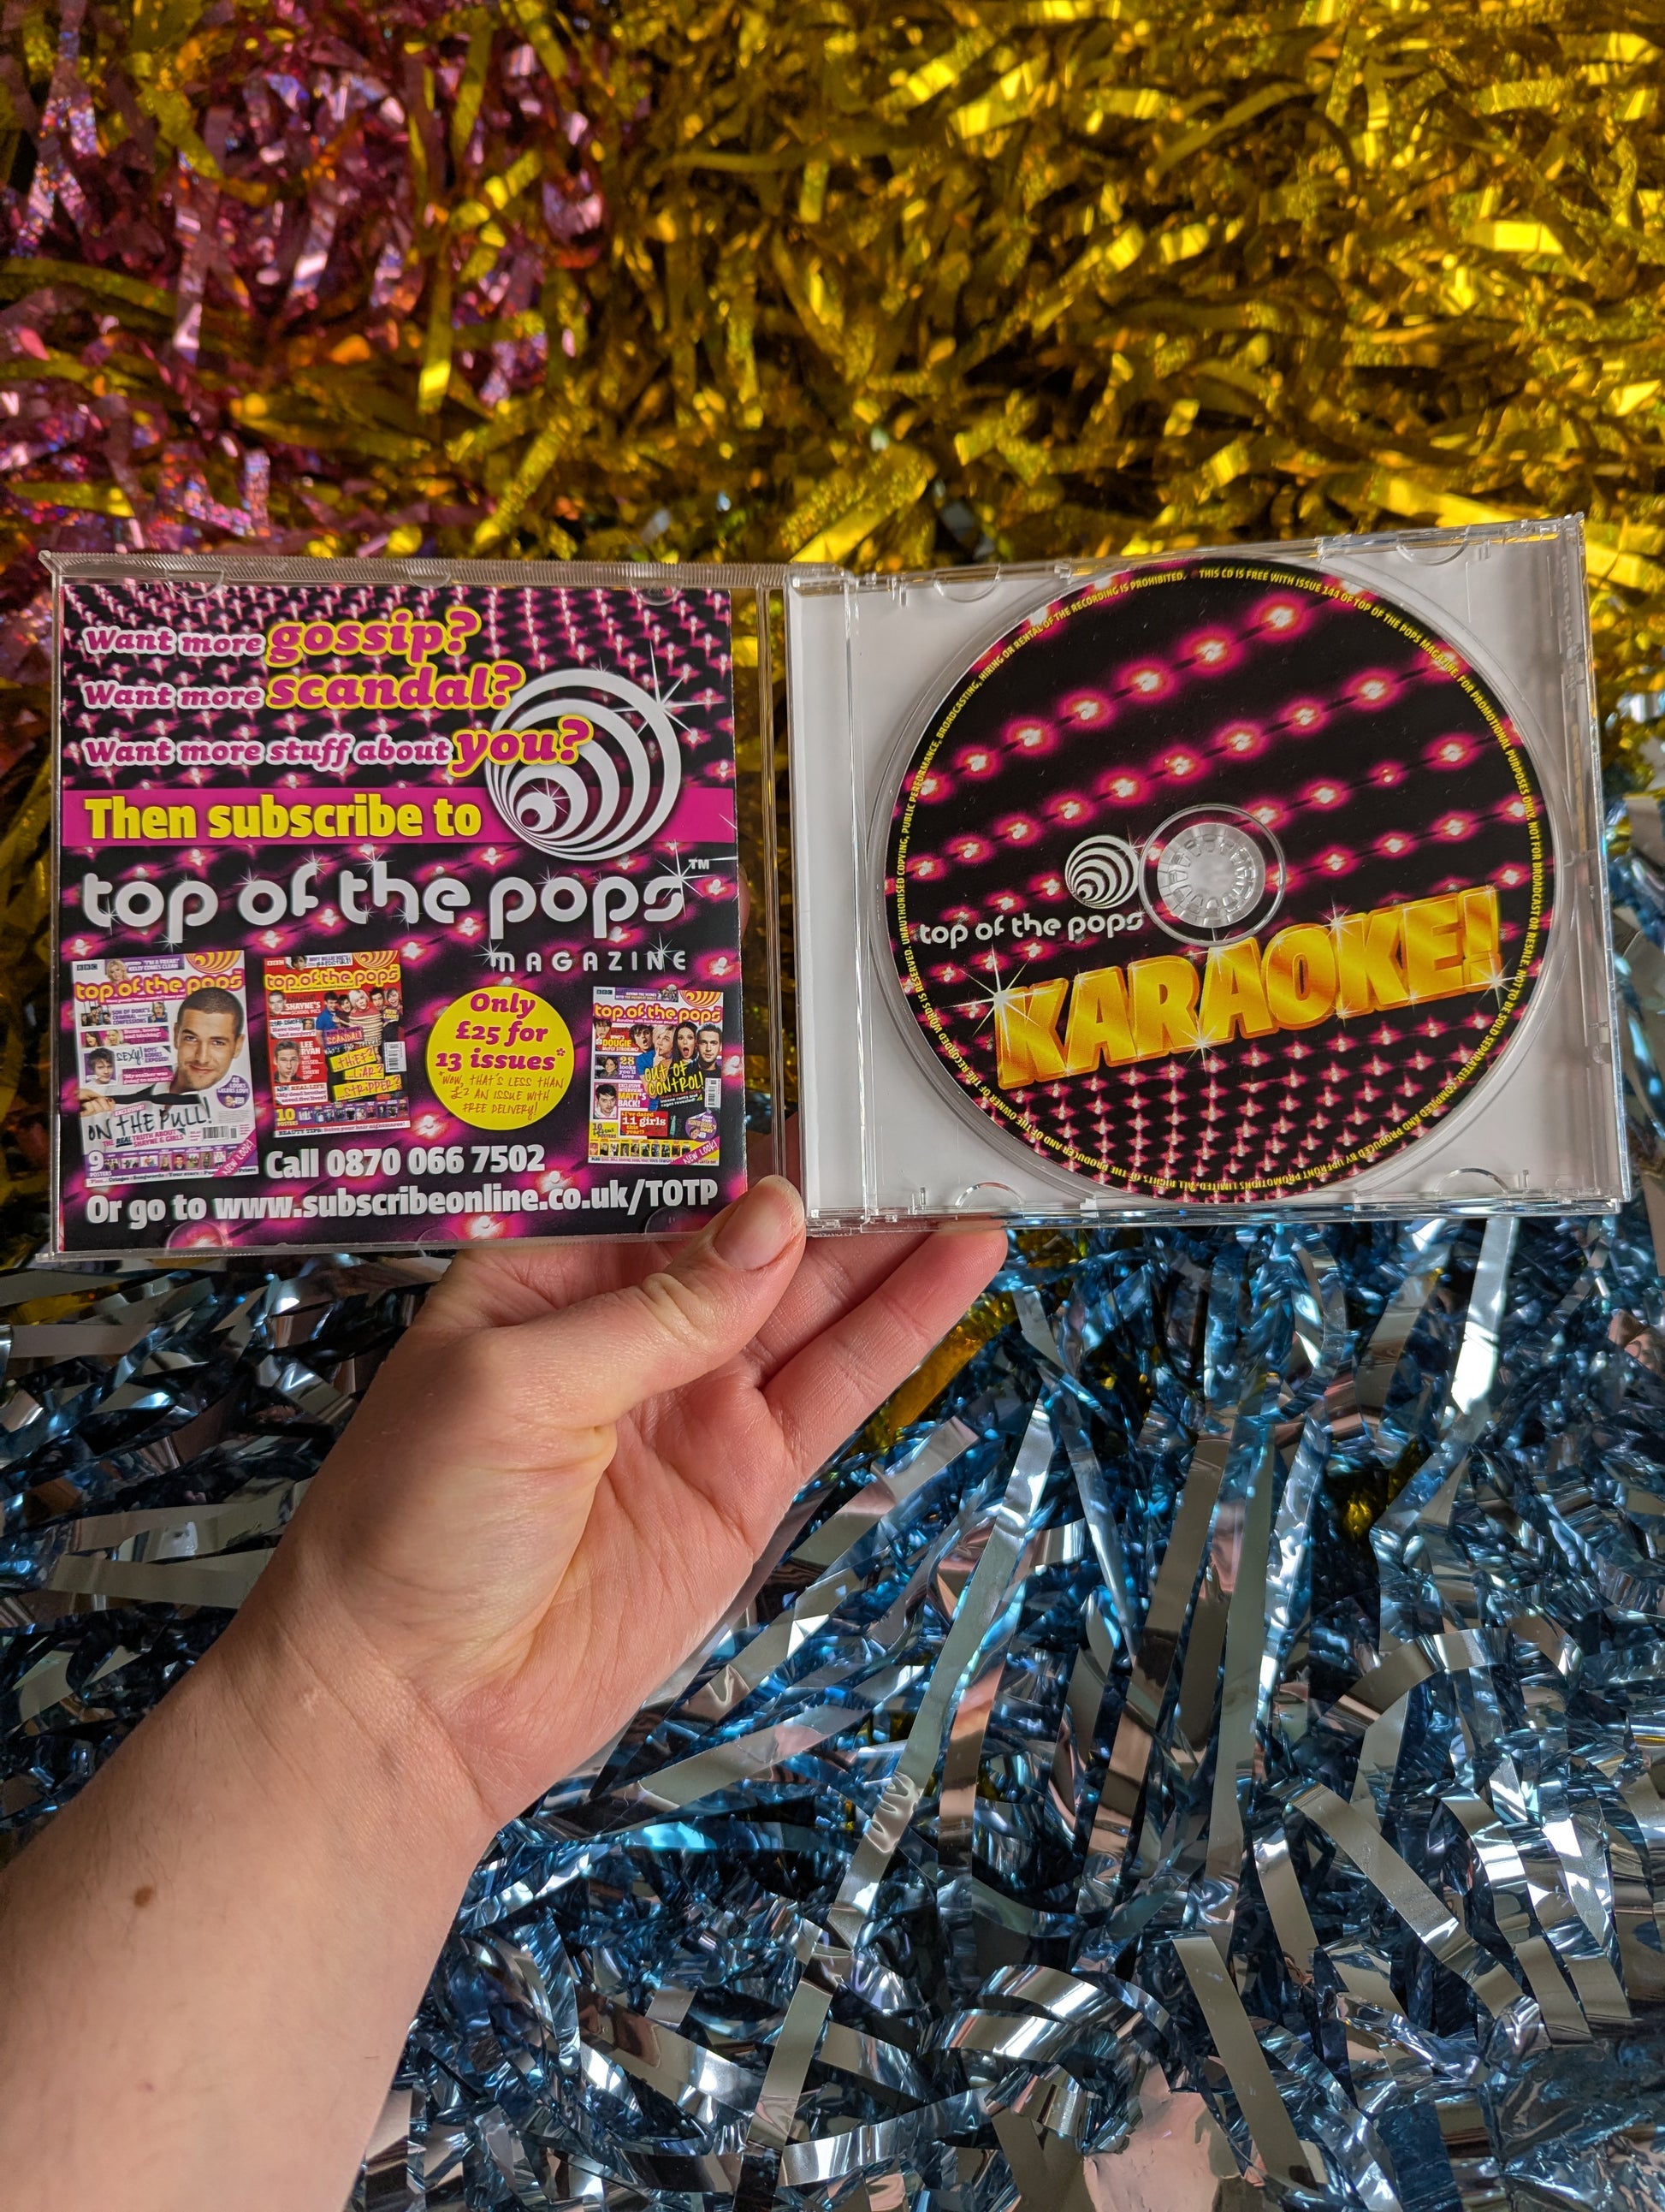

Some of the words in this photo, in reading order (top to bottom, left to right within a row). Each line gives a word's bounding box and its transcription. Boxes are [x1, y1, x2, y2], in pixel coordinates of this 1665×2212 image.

[1198, 568, 1219, 578] THIS
[1221, 568, 1234, 578] CD
[1235, 568, 1244, 578] IS
[1245, 569, 1270, 581] FREE
[1269, 572, 1295, 585] WITH
[1118, 582, 1130, 594] IS
[1294, 577, 1323, 593] ISSUE
[1320, 584, 1341, 599] 144
[1070, 585, 1120, 614] RECORDING
[1339, 591, 1355, 605] OF
[1352, 596, 1372, 613] TOP
[1040, 614, 1057, 630] OF
[1053, 606, 1072, 622] THE
[1369, 605, 1384, 619] OF
[1381, 612, 1401, 629] THE
[83, 626, 176, 655] Want
[178, 633, 265, 657] more
[265, 607, 481, 667] gossip?
[1011, 622, 1045, 650] RENTAL
[1397, 622, 1423, 643] POPS
[1000, 644, 1016, 660] OR
[977, 654, 1005, 682] HIRING
[83, 680, 175, 709] Want
[177, 686, 265, 709] more
[266, 661, 526, 710] scandal?
[1455, 673, 1475, 694] FOR
[1468, 690, 1512, 750] PROMOTIONAL
[82, 737, 175, 766] Want
[177, 740, 264, 766] more
[267, 733, 354, 772] stuff
[353, 734, 453, 765] about
[448, 715, 594, 777] you?
[1503, 748, 1530, 796] PURPOSES
[84, 796, 197, 839] Then
[208, 793, 424, 838] subscribe
[434, 798, 481, 837] to
[900, 802, 915, 834] PUBLIC
[1520, 795, 1536, 821] ONLY.
[1526, 821, 1539, 841] NOT
[896, 833, 909, 875] COPYING,
[1530, 841, 1541, 861] FOR
[1529, 862, 1542, 916] BROADCAST
[83, 872, 218, 944] top
[237, 860, 319, 926] of
[339, 861, 471, 925] the
[489, 875, 685, 940] pops
[896, 876, 911, 945] UNAUTHORISED
[920, 922, 968, 949] top
[975, 915, 1005, 940] of
[1012, 912, 1061, 939] the
[1068, 912, 1145, 940] pops
[1527, 916, 1538, 931] OR
[1518, 931, 1536, 969] RESALE.
[490, 951, 686, 972] MAGAZINE
[267, 976, 296, 990] top
[300, 971, 319, 985] of
[322, 971, 352, 985] the
[355, 967, 399, 987] pops
[994, 886, 1502, 1089] KARAOKE!
[1511, 968, 1526, 989] NOT
[75, 983, 114, 1003] top
[118, 978, 140, 997] of
[145, 976, 182, 994] the
[917, 991, 928, 1002] IS
[1505, 987, 1520, 1002] TO
[286, 1001, 321, 1010] SHAYNE'S
[471, 993, 536, 1019] Only
[595, 1004, 624, 1021] top
[626, 1004, 644, 1018] of
[648, 1005, 676, 1019] the
[679, 1008, 721, 1023] pops
[1500, 999, 1514, 1014] BE
[921, 1000, 944, 1034] WORDS
[1488, 1011, 1508, 1037] SOLD
[456, 1021, 501, 1045] £25
[504, 1020, 548, 1047] for
[619, 1056, 635, 1065] 28
[937, 1030, 970, 1073] RECORDED
[436, 1053, 462, 1072] 13
[644, 1064, 667, 1082] OUT
[673, 1060, 688, 1076] OF
[508, 1077, 531, 1086] LESS
[537, 1077, 564, 1088] THAN
[649, 1071, 704, 1095] CONTROL!
[964, 1069, 983, 1088] THE
[451, 1087, 469, 1100] £2
[474, 1089, 489, 1100] AN
[494, 1090, 521, 1100] ISSUE
[527, 1090, 550, 1101] WITH
[618, 1092, 646, 1100] MATT'S
[976, 1082, 992, 1097] OF
[1417, 1080, 1458, 1118] COMPILED
[276, 1108, 295, 1121] 10
[463, 1103, 487, 1113] FREE
[492, 1102, 537, 1120] DELIVERY!
[987, 1093, 1018, 1121] OWNER
[88, 1118, 112, 1141] ON
[159, 1096, 212, 1130] PULL!
[639, 1117, 666, 1127] girls
[1013, 1115, 1033, 1133] THE
[1400, 1112, 1422, 1132] AND
[116, 1136, 132, 1145] REAL
[132, 1133, 154, 1142] TRUTH
[155, 1130, 176, 1138] ABOUT
[1028, 1126, 1044, 1141] OF
[1040, 1134, 1063, 1152] AND
[1355, 1125, 1404, 1159] PRODUCED
[88, 1151, 104, 1171] 9
[222, 1159, 238, 1175] NEW
[237, 1139, 256, 1159] LOOK!
[266, 1148, 319, 1179] Call
[326, 1148, 401, 1177] 0870
[408, 1146, 464, 1175] 066
[471, 1145, 545, 1173] 7502
[683, 1151, 698, 1165] NEW
[700, 1140, 718, 1155] LOOK!
[1060, 1144, 1109, 1172] PRODUCER
[1342, 1151, 1358, 1165] BY
[1108, 1165, 1128, 1178] THE
[1127, 1170, 1142, 1182] OF
[1301, 1157, 1345, 1179] UPFRONT
[1141, 1173, 1176, 1189] RIGHTS
[1176, 1179, 1195, 1190] ALL
[1238, 1171, 1301, 1190] PROMOTIONS
[86, 1195, 121, 1224] Or
[128, 1198, 166, 1230] go
[173, 1195, 206, 1220] to
[214, 1179, 718, 1219] www.subscribeonline.co.uk/TOTP
